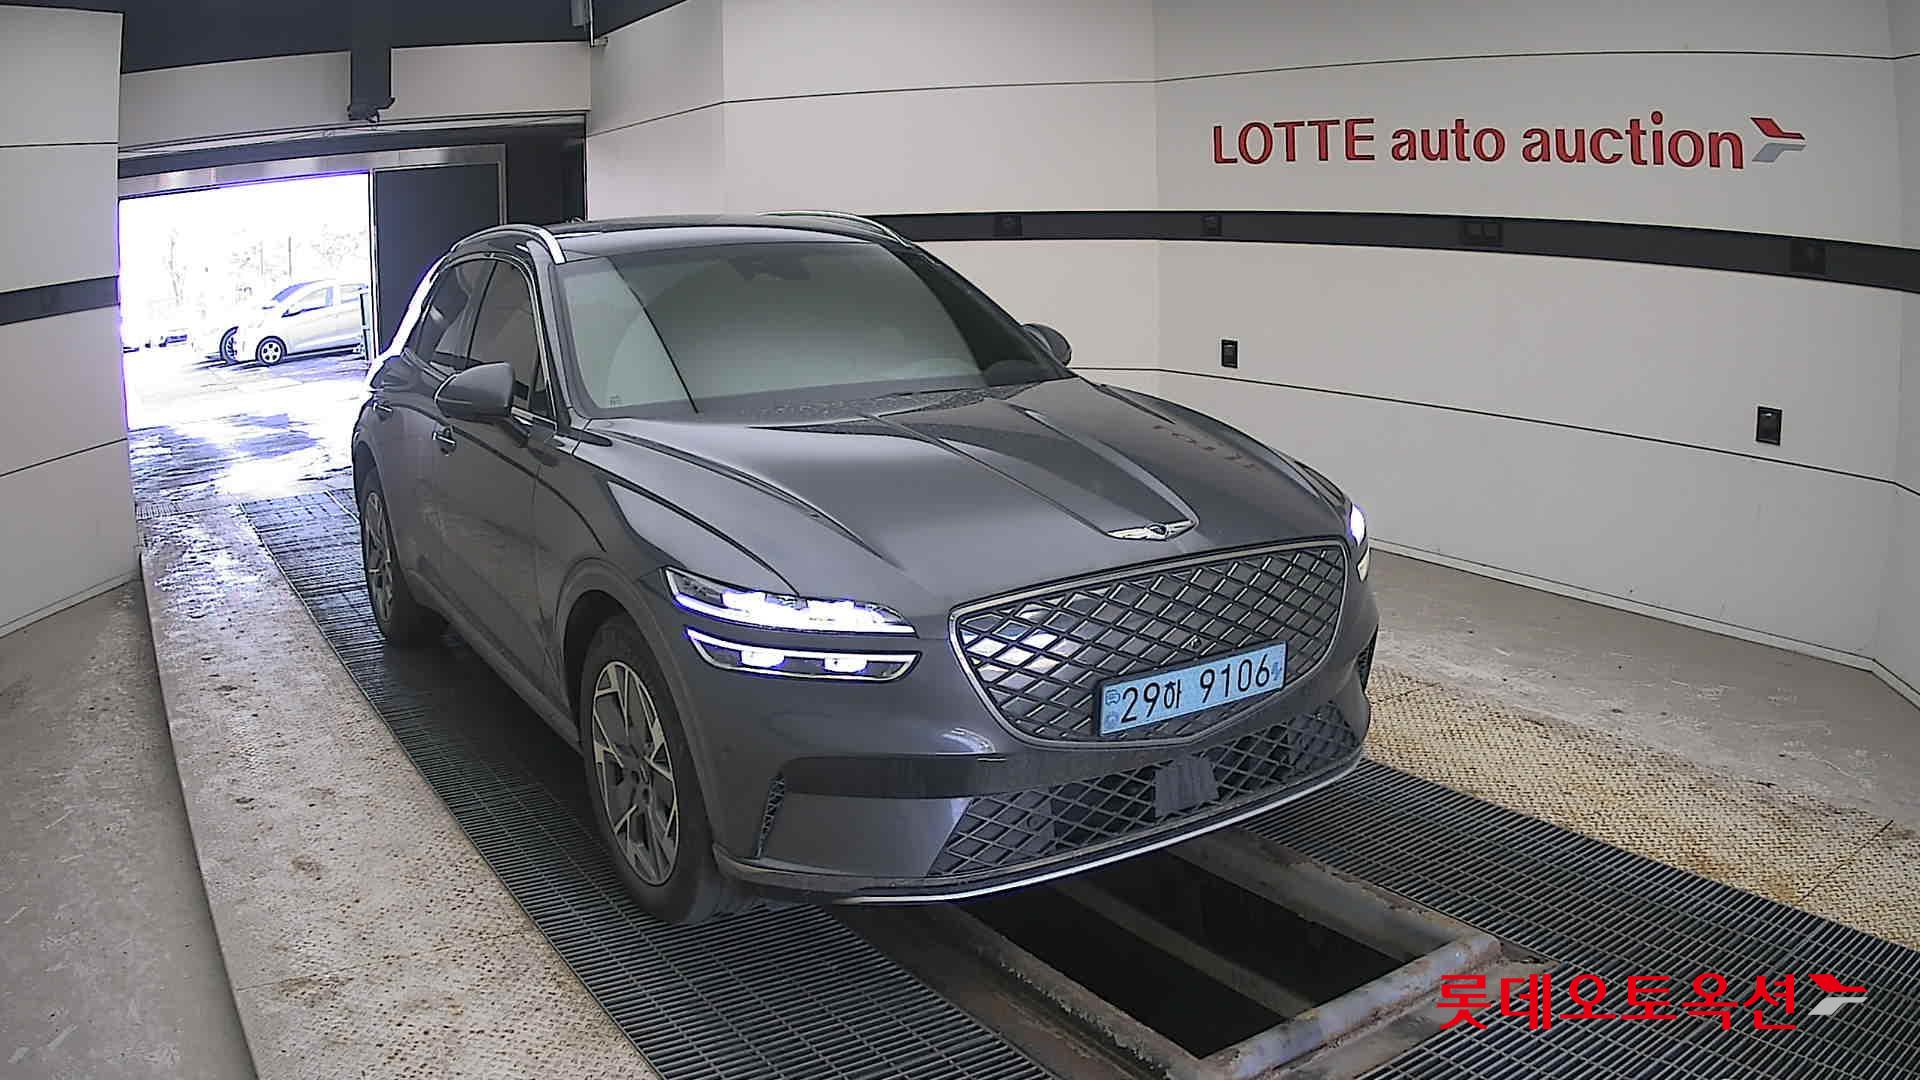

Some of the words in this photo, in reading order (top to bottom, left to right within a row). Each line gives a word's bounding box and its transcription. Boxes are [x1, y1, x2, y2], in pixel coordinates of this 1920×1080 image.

[1213, 118, 1375, 164] LOTTE
[1391, 118, 1504, 163] auto
[1522, 111, 1744, 169] auction
[1120, 679, 1182, 724] 29하
[1199, 653, 1270, 704] 9106
